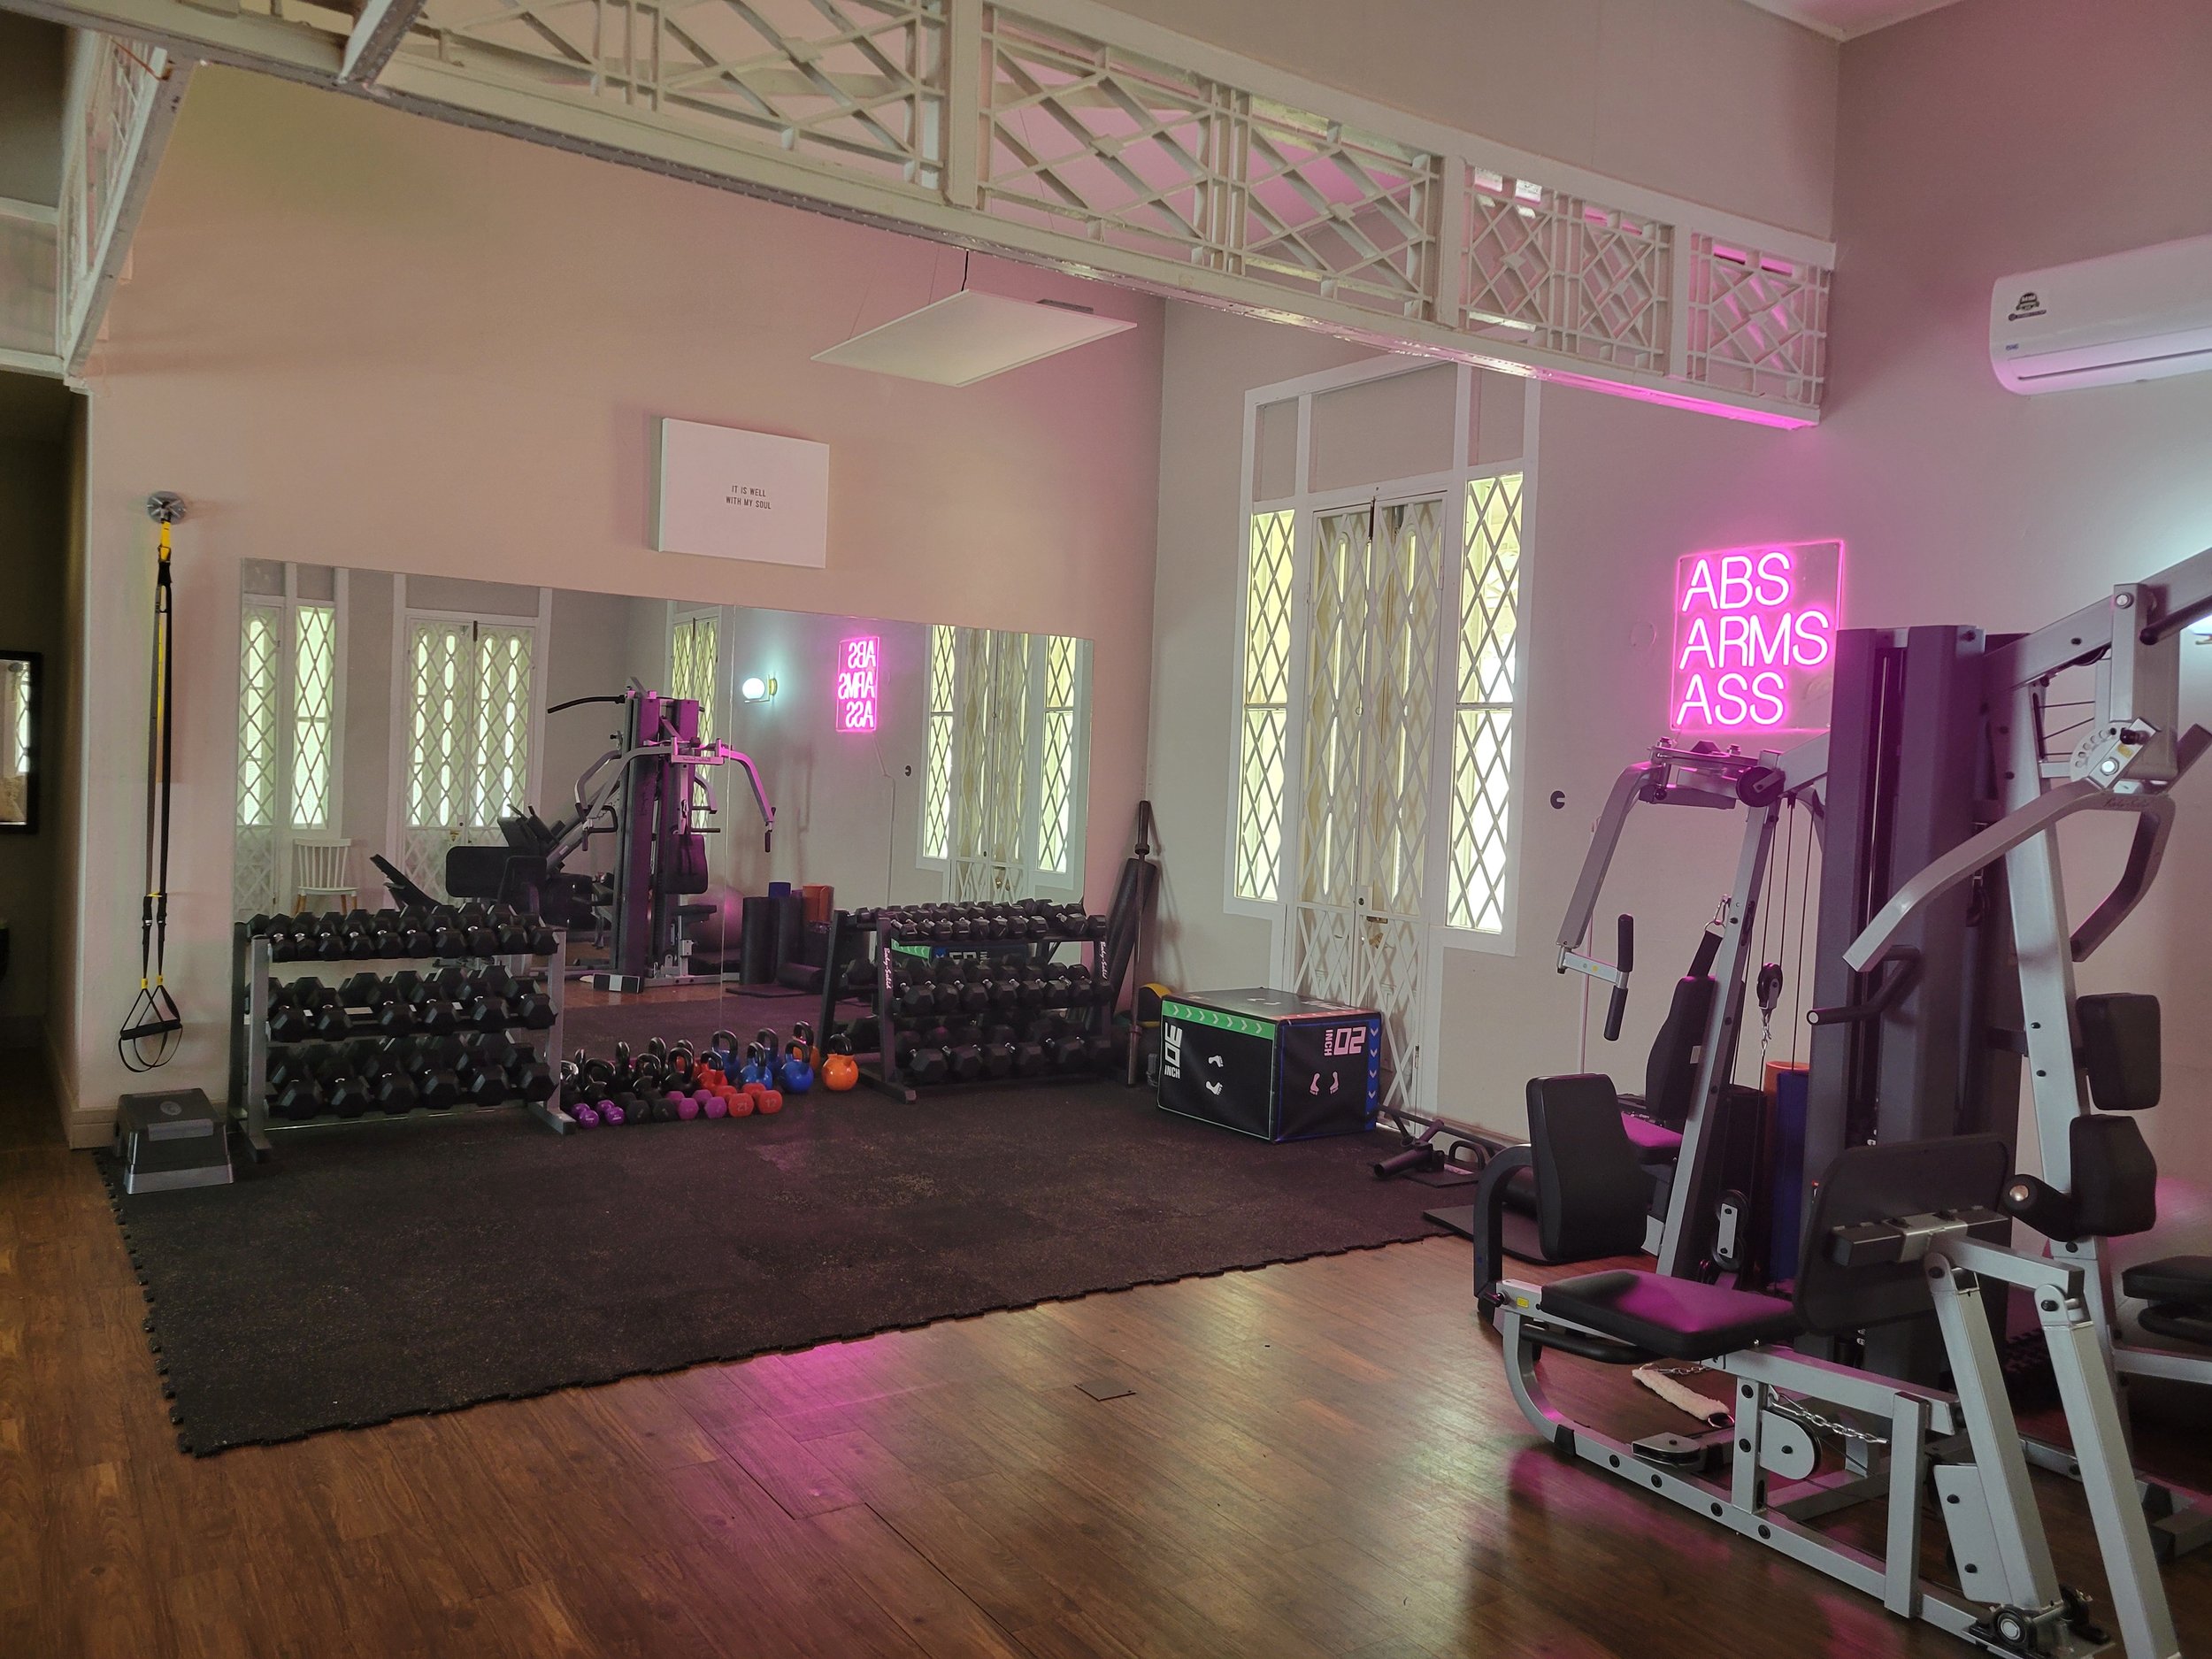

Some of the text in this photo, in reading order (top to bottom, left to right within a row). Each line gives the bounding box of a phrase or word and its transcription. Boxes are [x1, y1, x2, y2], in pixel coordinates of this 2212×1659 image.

[726, 496, 741, 505] WITH
[755, 500, 772, 510] SOUL
[749, 488, 766, 497] WELL
[1681, 551, 1791, 612] ABS
[1678, 611, 1829, 670] ARMS
[1676, 671, 1785, 726] ASS
[1164, 1022, 1183, 1079] 30 INCH
[1324, 1026, 1367, 1056] 20 INCH
[764, 1097, 777, 1108] 12
